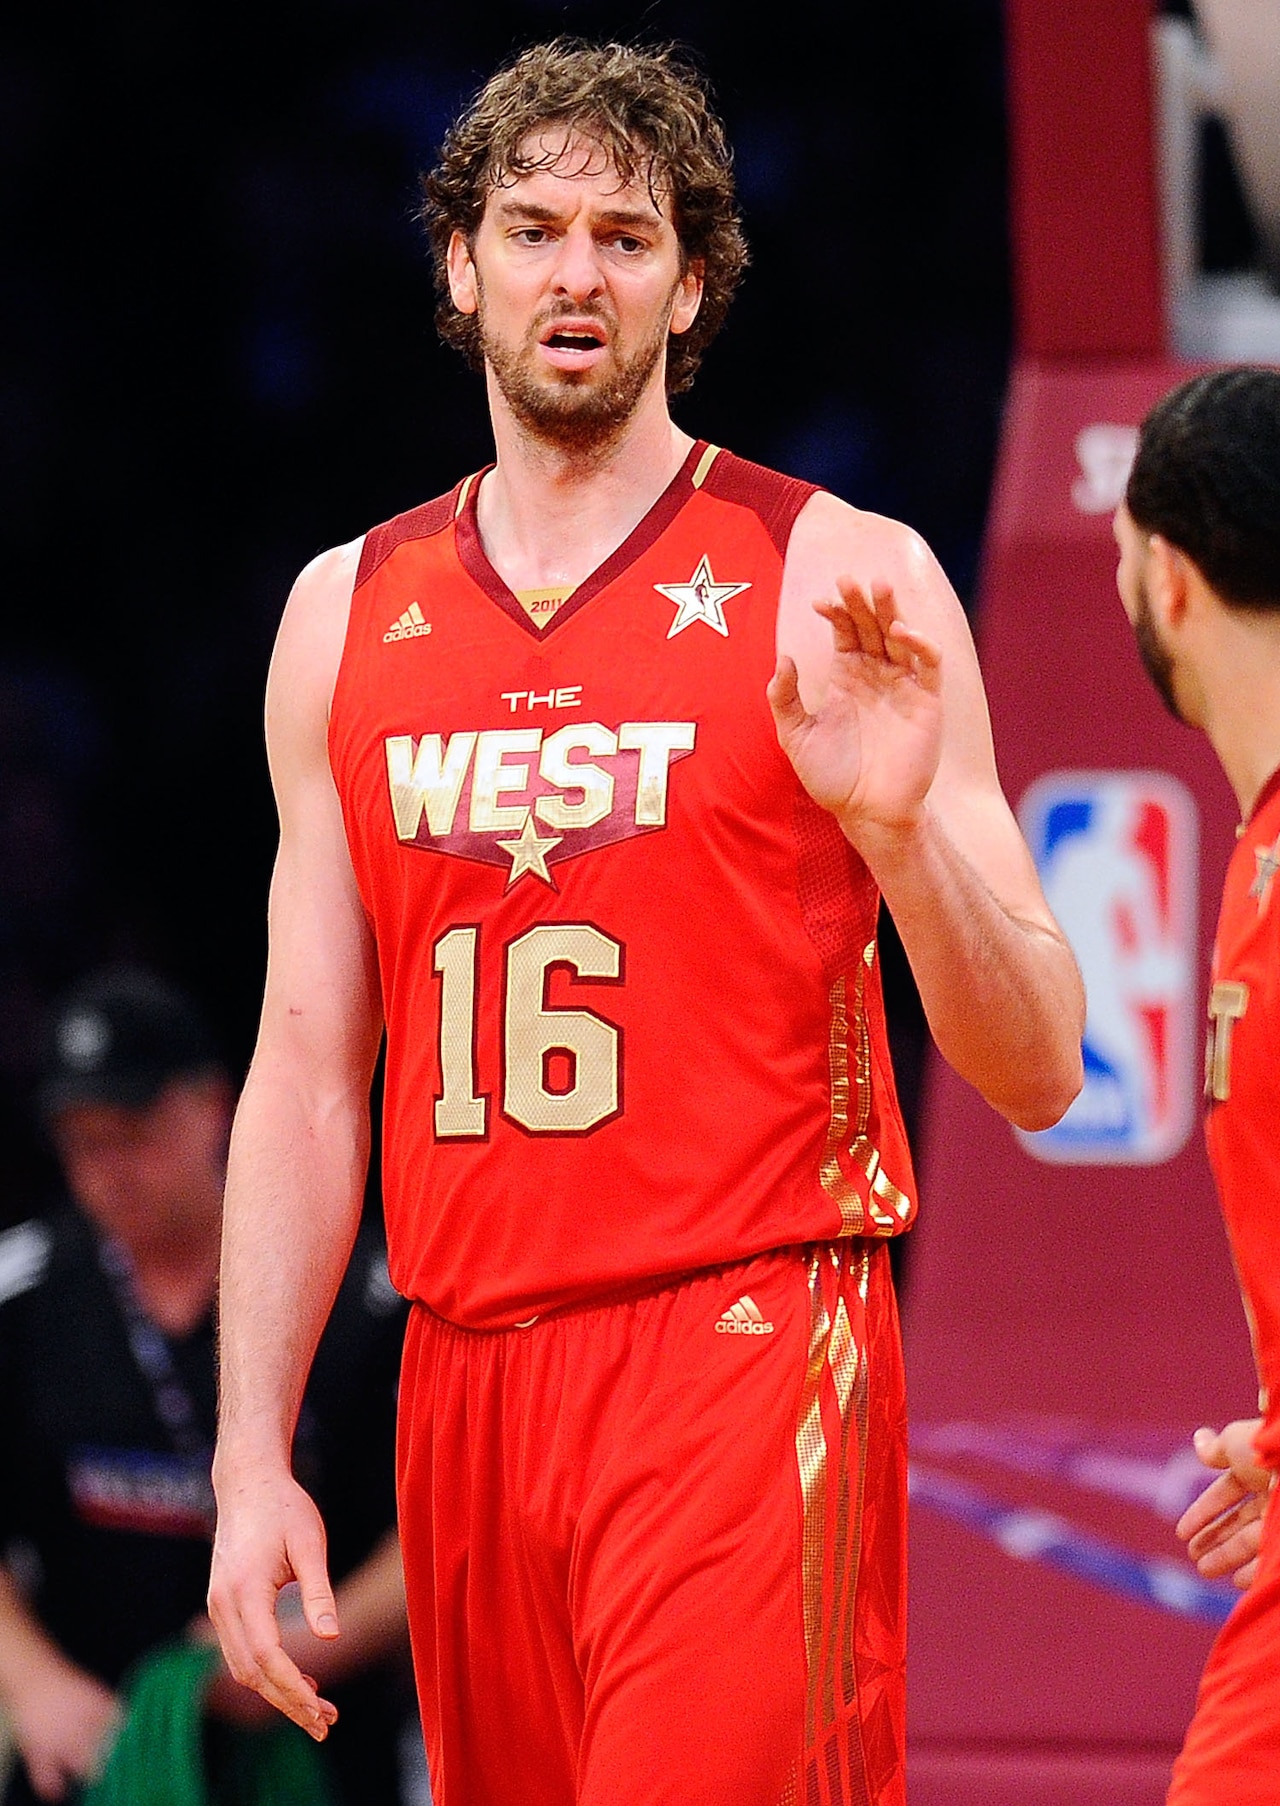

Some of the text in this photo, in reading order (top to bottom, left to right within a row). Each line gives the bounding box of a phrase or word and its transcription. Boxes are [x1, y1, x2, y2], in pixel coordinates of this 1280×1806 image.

[383, 623, 432, 643] adidas
[501, 685, 583, 713] THE
[385, 721, 697, 841] WEST
[432, 921, 626, 1143] 16
[714, 1319, 775, 1335] adidas
